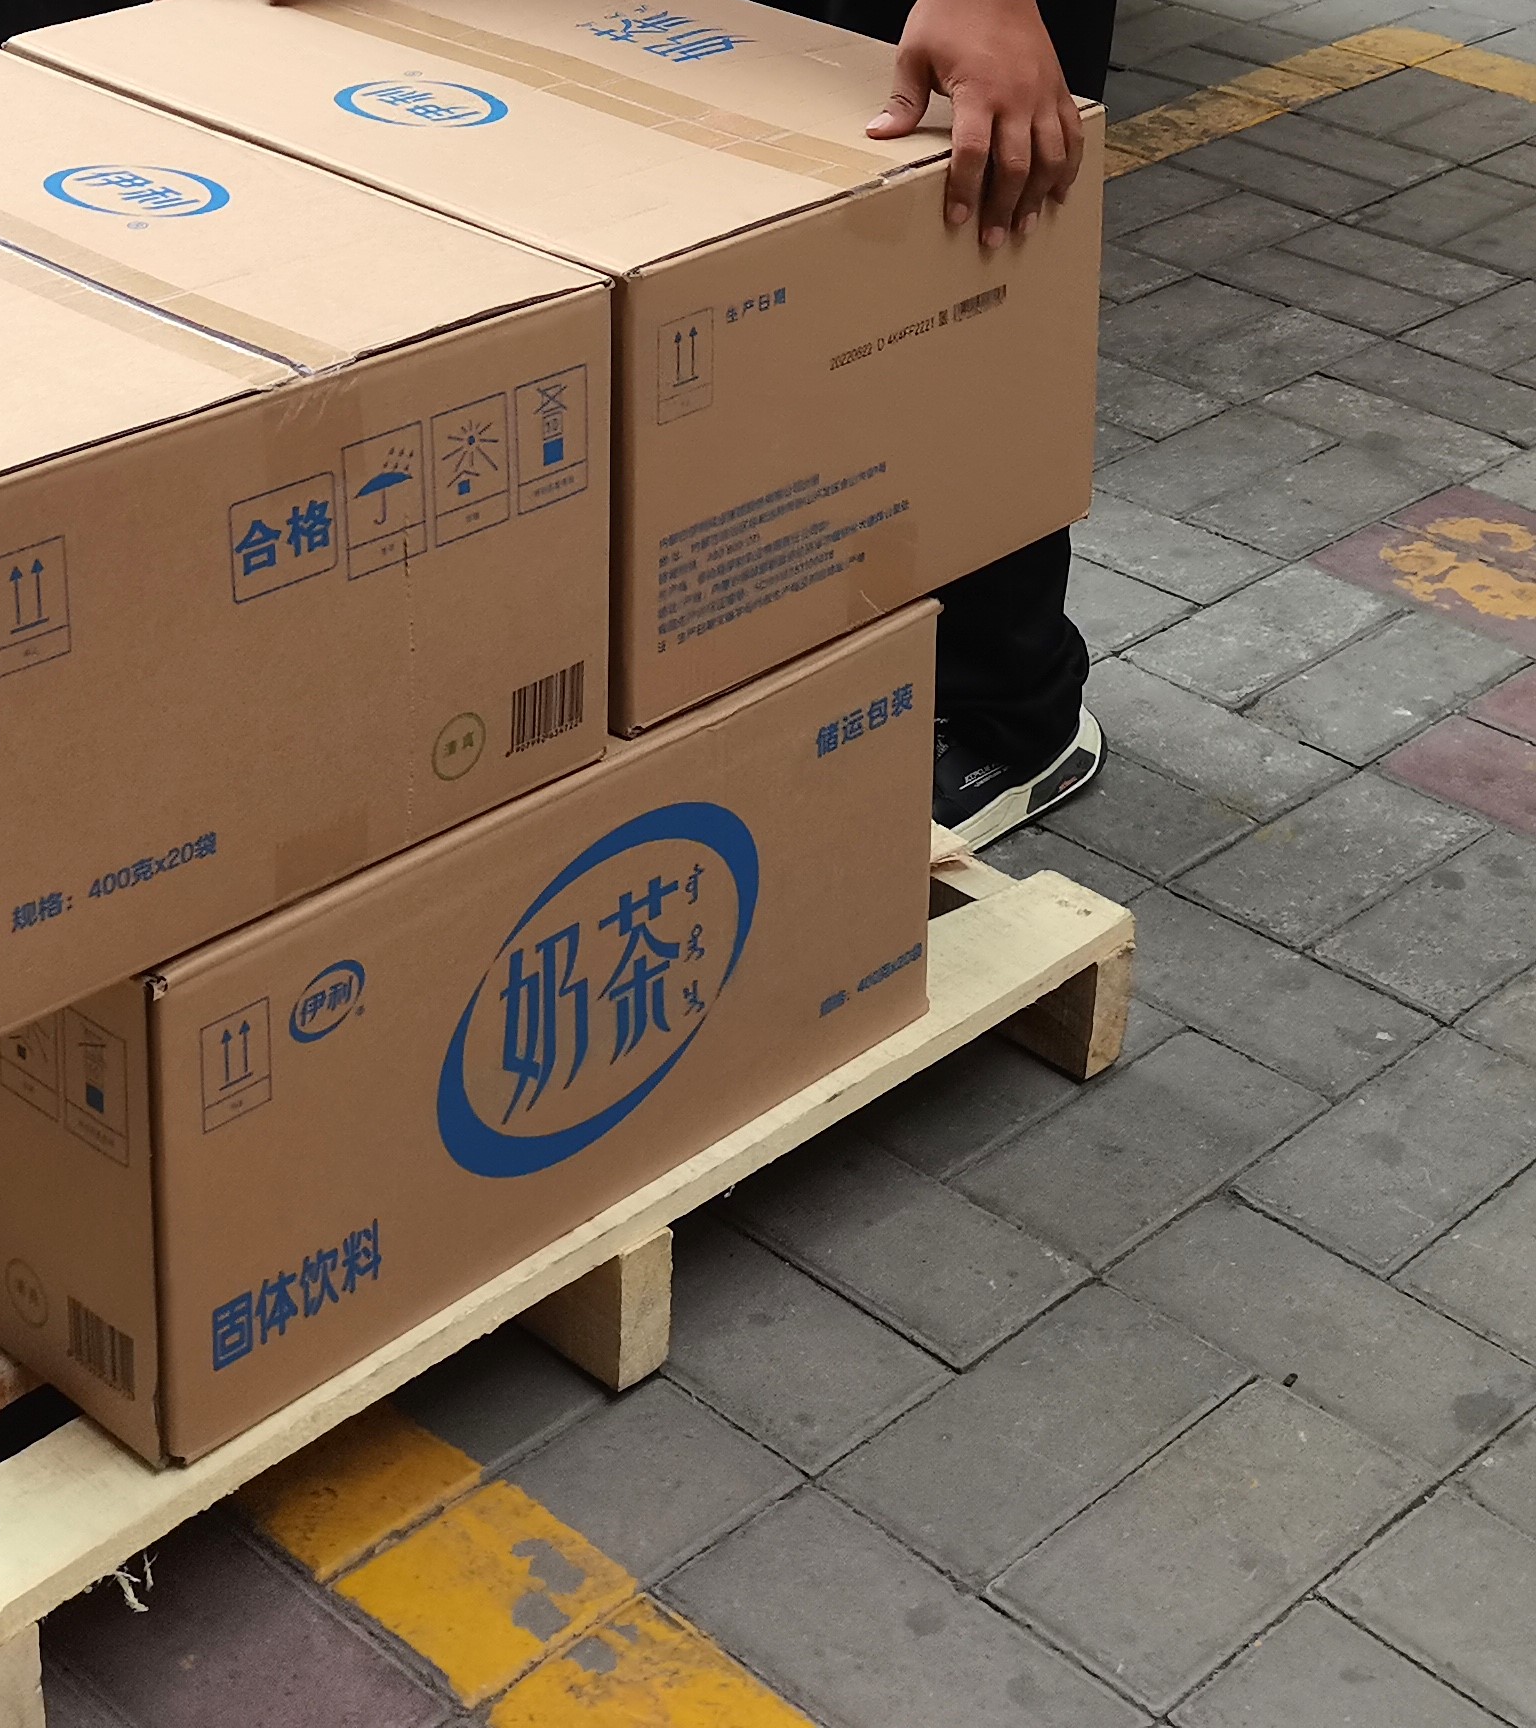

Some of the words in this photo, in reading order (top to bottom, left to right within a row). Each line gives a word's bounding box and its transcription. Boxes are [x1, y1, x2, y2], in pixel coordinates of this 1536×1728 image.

[363, 85, 482, 122] 伊利
[76, 170, 199, 211] 伊利
[725, 286, 787, 325] 生产日期
[235, 500, 332, 577] 合格
[815, 682, 915, 760] 储运包装
[299, 974, 354, 1027] 伊利
[499, 875, 681, 1125] 奶茶
[211, 1218, 383, 1372] 固体饮料
